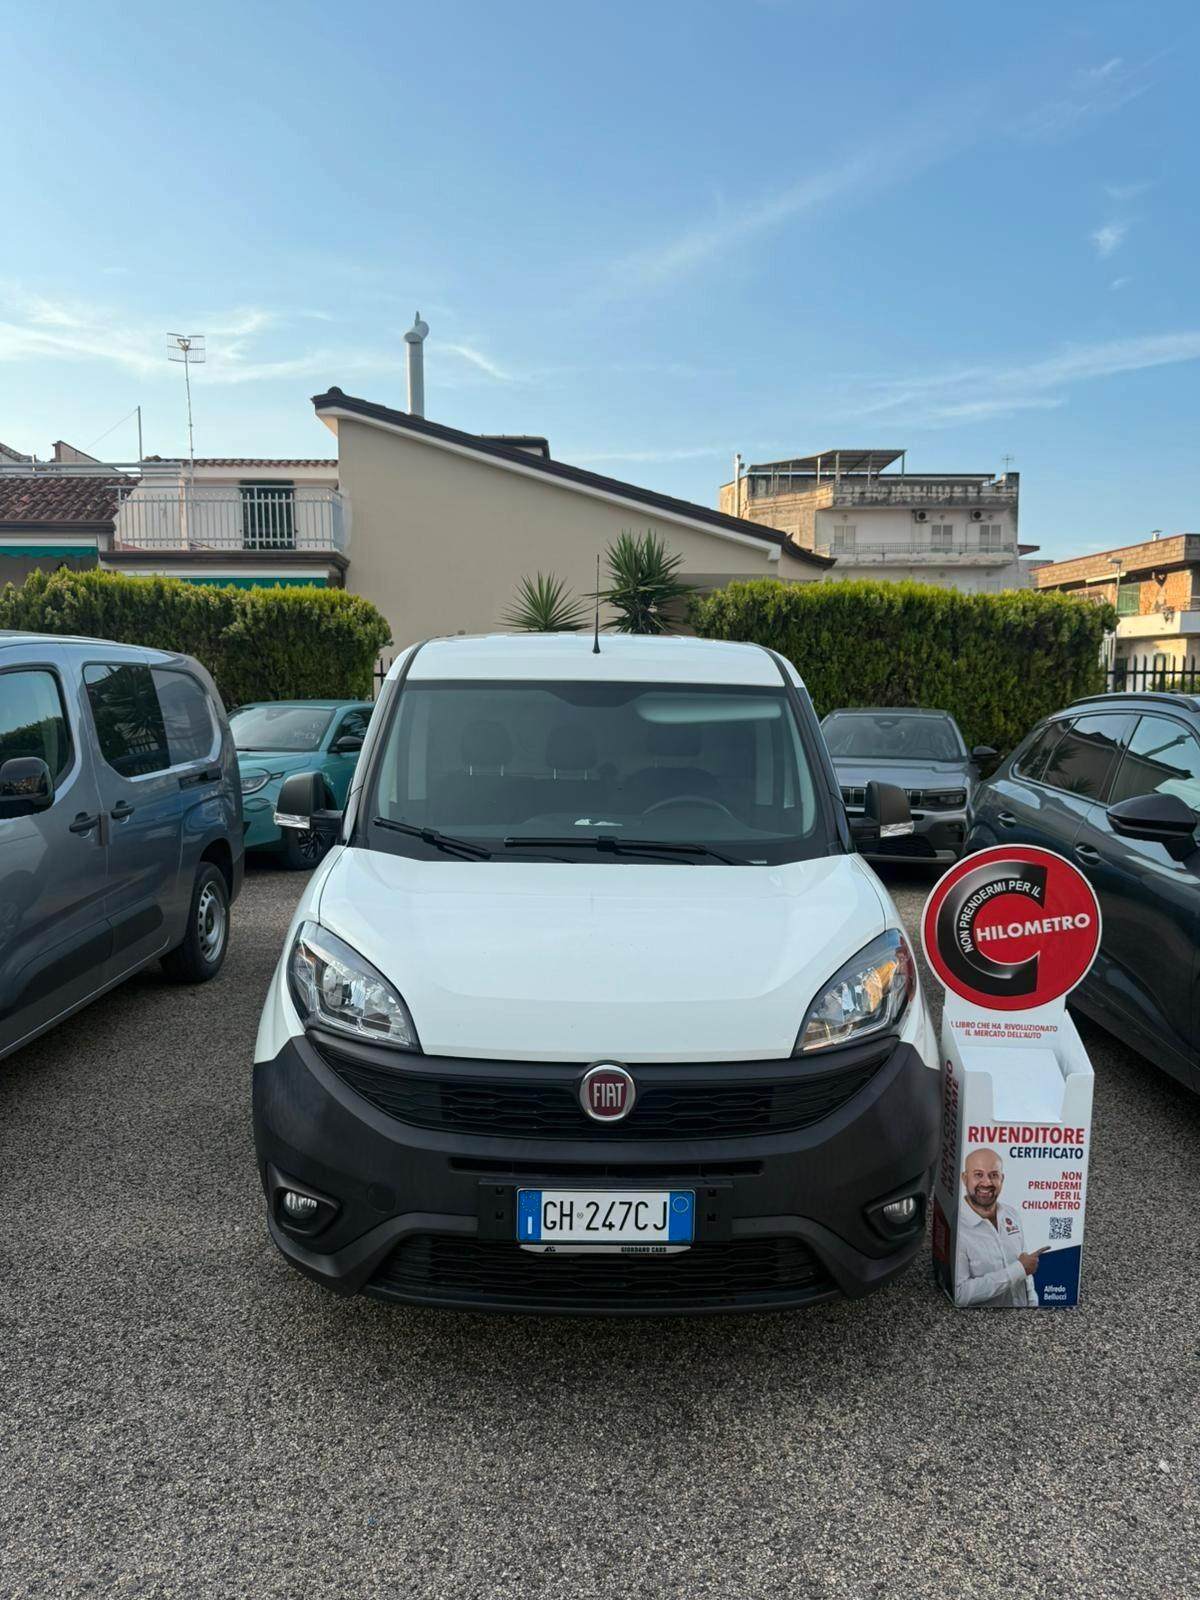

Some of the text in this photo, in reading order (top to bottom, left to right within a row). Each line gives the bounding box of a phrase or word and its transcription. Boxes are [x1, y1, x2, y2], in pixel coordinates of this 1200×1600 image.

[959, 880, 1041, 953] NON PRENDERMI PER IL
[955, 1021, 976, 1029] LIBRO
[977, 1022, 990, 1030] CHE
[992, 1022, 1002, 1030] HA
[1004, 1023, 1058, 1032] RIVOLUZIONATO
[974, 1029, 1006, 1038] MERCATO
[1007, 1031, 1042, 1039] DELL'AUTO
[593, 1082, 624, 1107] FIAT
[967, 1126, 1085, 1144] RIVENDITORE
[1009, 1146, 1084, 1159] CERTIFICATO
[1061, 1171, 1082, 1181] NON
[1028, 1181, 1082, 1190] PRENDERMI
[1054, 1191, 1082, 1200] PER IL
[1022, 1201, 1081, 1210] CHILOMETRO
